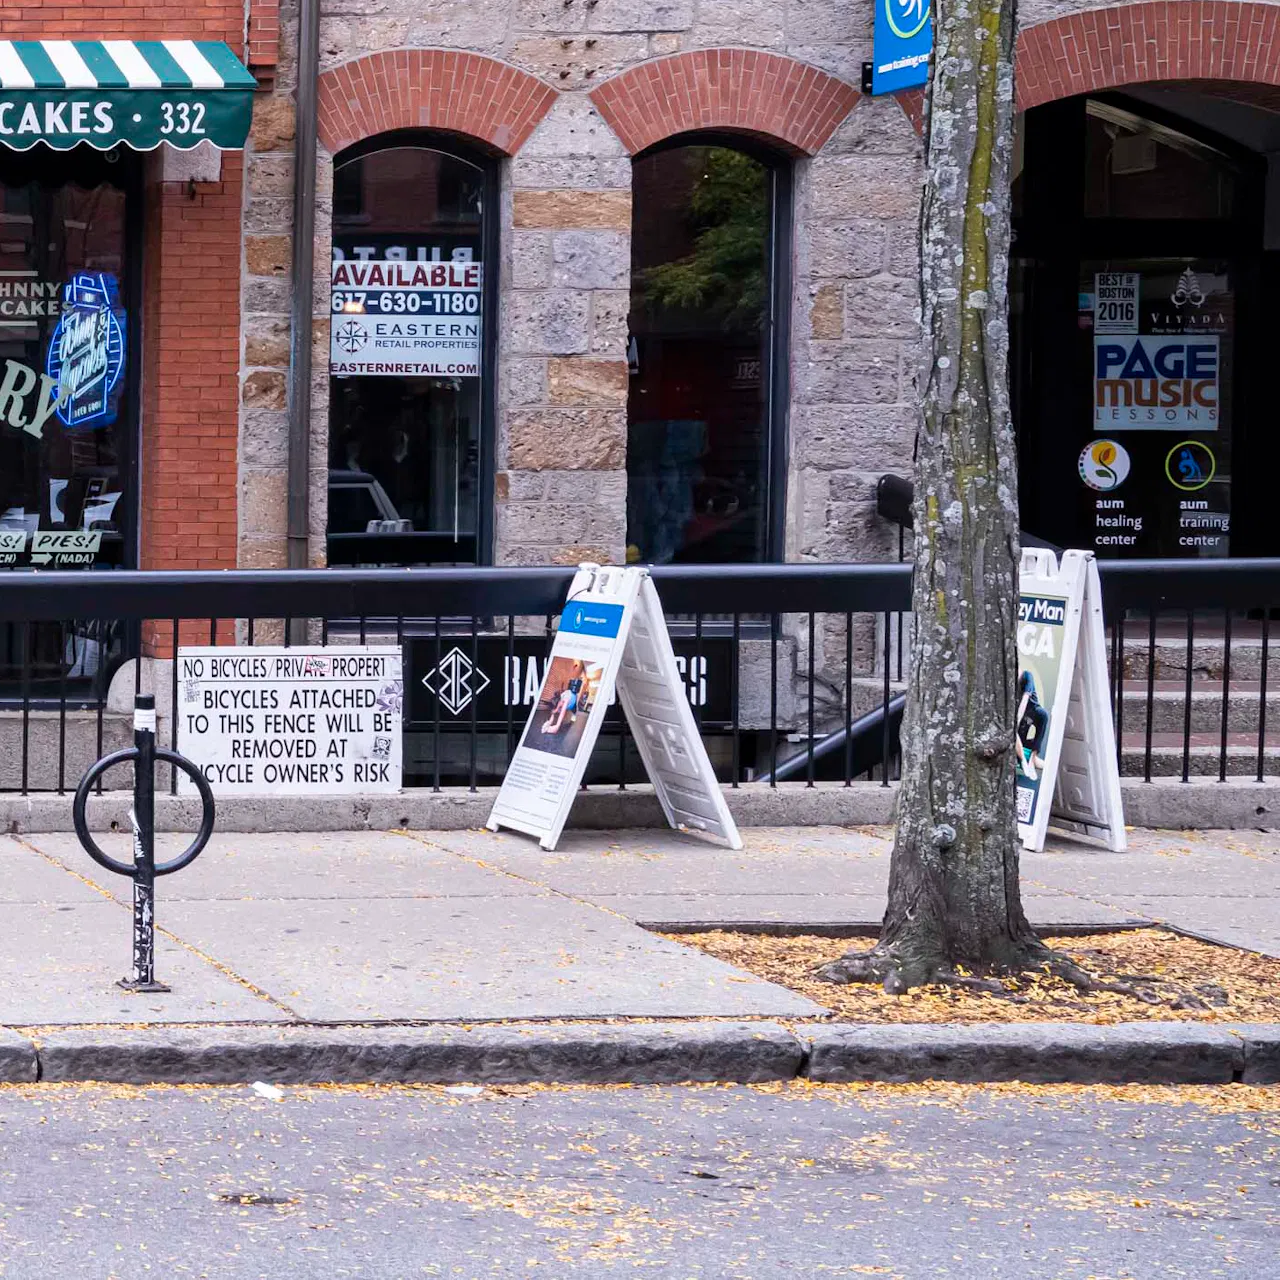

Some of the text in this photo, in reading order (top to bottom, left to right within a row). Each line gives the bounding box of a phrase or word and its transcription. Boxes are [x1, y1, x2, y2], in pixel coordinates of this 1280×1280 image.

[160, 102, 206, 134] 332
[332, 265, 478, 287] AVAILABLE
[1099, 274, 1123, 286] BEST
[1099, 288, 1135, 299] BOSTON
[332, 292, 478, 313] 617-630-1180
[1099, 302, 1134, 320] 2016
[376, 324, 478, 336] EASTERN
[375, 340, 478, 349] RETAIL PROPERTIES
[1096, 338, 1217, 379] PAGE
[331, 363, 477, 373] EASTERNRETAIL.COM
[1096, 409, 1217, 420] LESSONS
[1096, 500, 1124, 509] aum
[1180, 500, 1208, 509] aum
[1096, 515, 1142, 530] healing
[1180, 516, 1230, 531] training
[37, 534, 97, 549] PIES!
[1095, 535, 1136, 545] center
[1179, 535, 1220, 545] center
[55, 553, 95, 565] (NADA)
[1034, 599, 1064, 621] Man
[1017, 624, 1055, 658] GA
[184, 658, 204, 678] NO
[211, 657, 326, 678] BICYCLES/PRIV
[204, 690, 279, 709] BICYCLES
[289, 689, 376, 708] ATTACHED
[187, 713, 392, 733] TO THIS FENCE WILL BE
[232, 739, 348, 758] REMOVED AT
[192, 763, 390, 783] ICYCLE OWNER'S RISK
